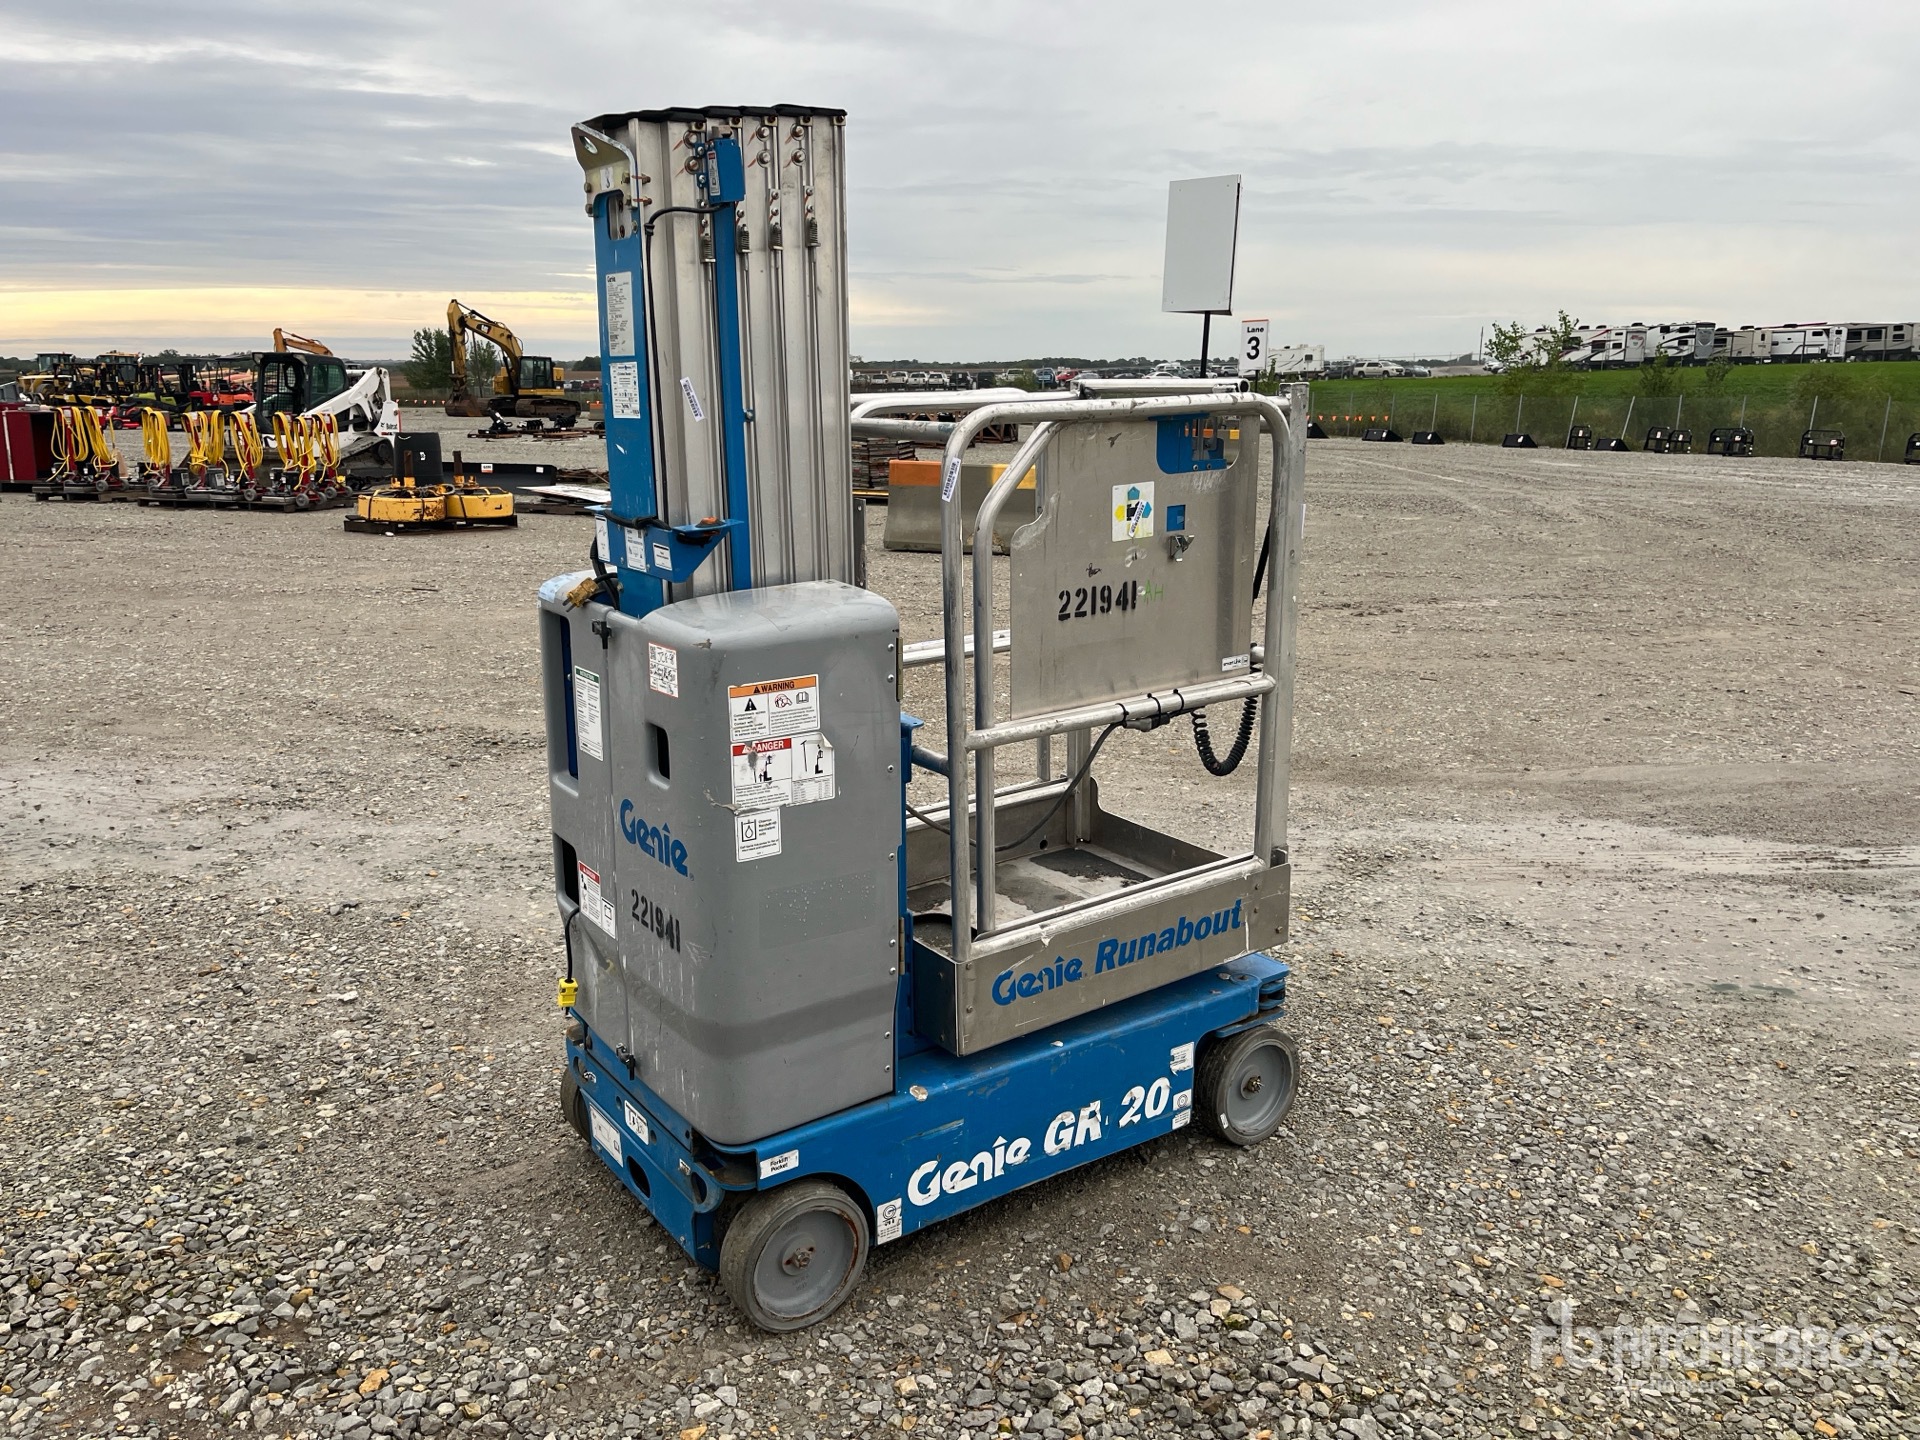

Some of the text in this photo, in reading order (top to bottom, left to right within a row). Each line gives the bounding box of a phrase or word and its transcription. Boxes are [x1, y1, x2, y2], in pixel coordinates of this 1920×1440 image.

[1246, 336, 1260, 360] 3
[1058, 580, 1137, 621] 221941
[761, 681, 795, 693] WARNING
[620, 799, 688, 877] Genie
[631, 889, 681, 953] 221941
[992, 898, 1242, 1006] Genie Runabout
[907, 1077, 1171, 1206] Genie GR 20
